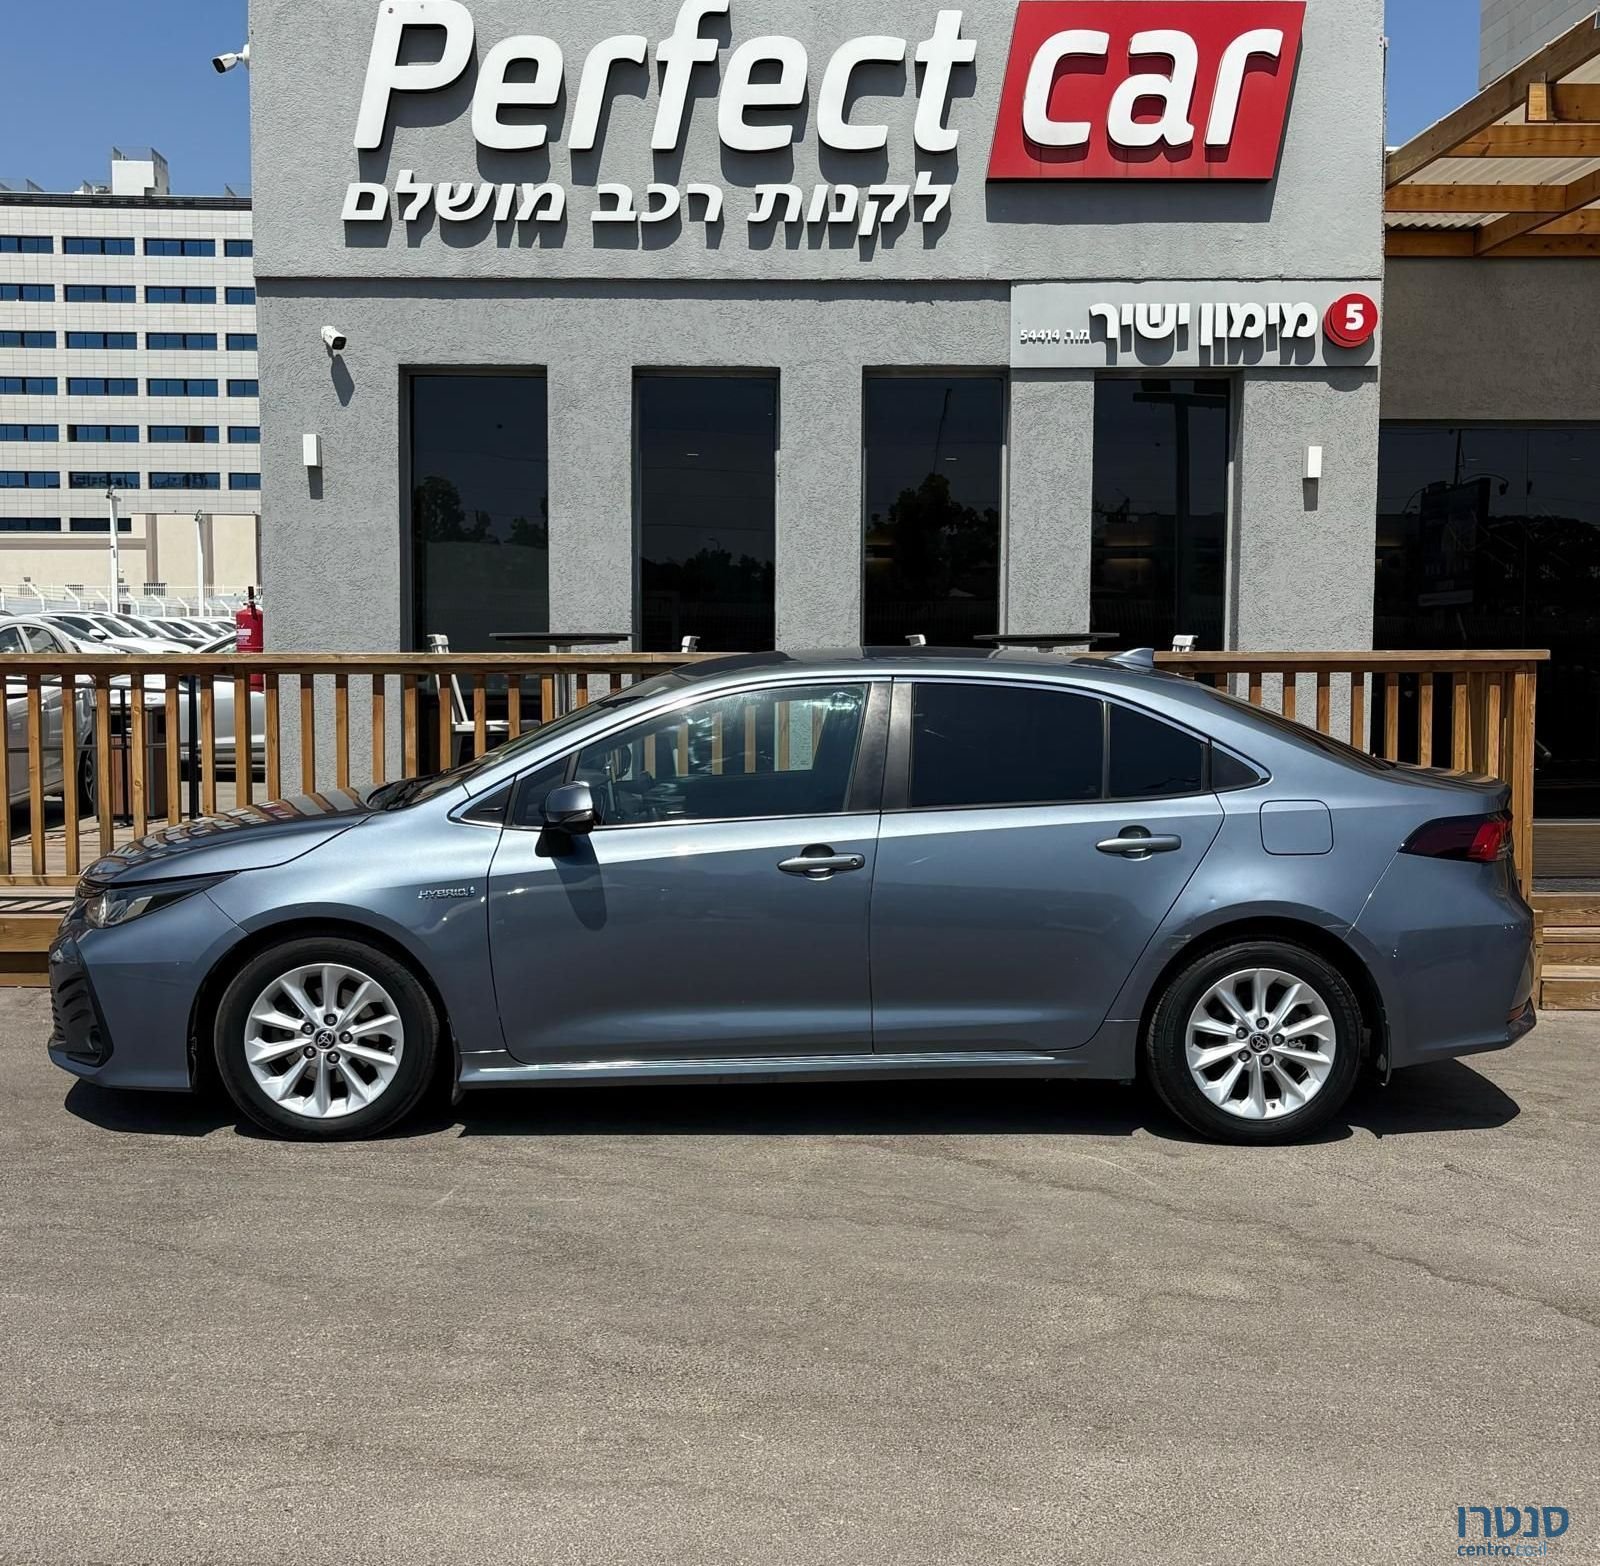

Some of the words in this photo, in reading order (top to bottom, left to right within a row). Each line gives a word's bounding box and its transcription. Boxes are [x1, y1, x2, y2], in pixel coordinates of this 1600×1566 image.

[353, 0, 977, 151] Perfect
[1022, 28, 1284, 147] car
[341, 169, 566, 222] מושלם
[591, 184, 725, 222] רכב
[747, 171, 952, 236] לקנות
[1020, 329, 1060, 340] 54414
[1089, 303, 1190, 339] ישיר
[1199, 302, 1318, 346] מימון
[1344, 303, 1365, 330] 5
[418, 888, 468, 898] HYBRID
